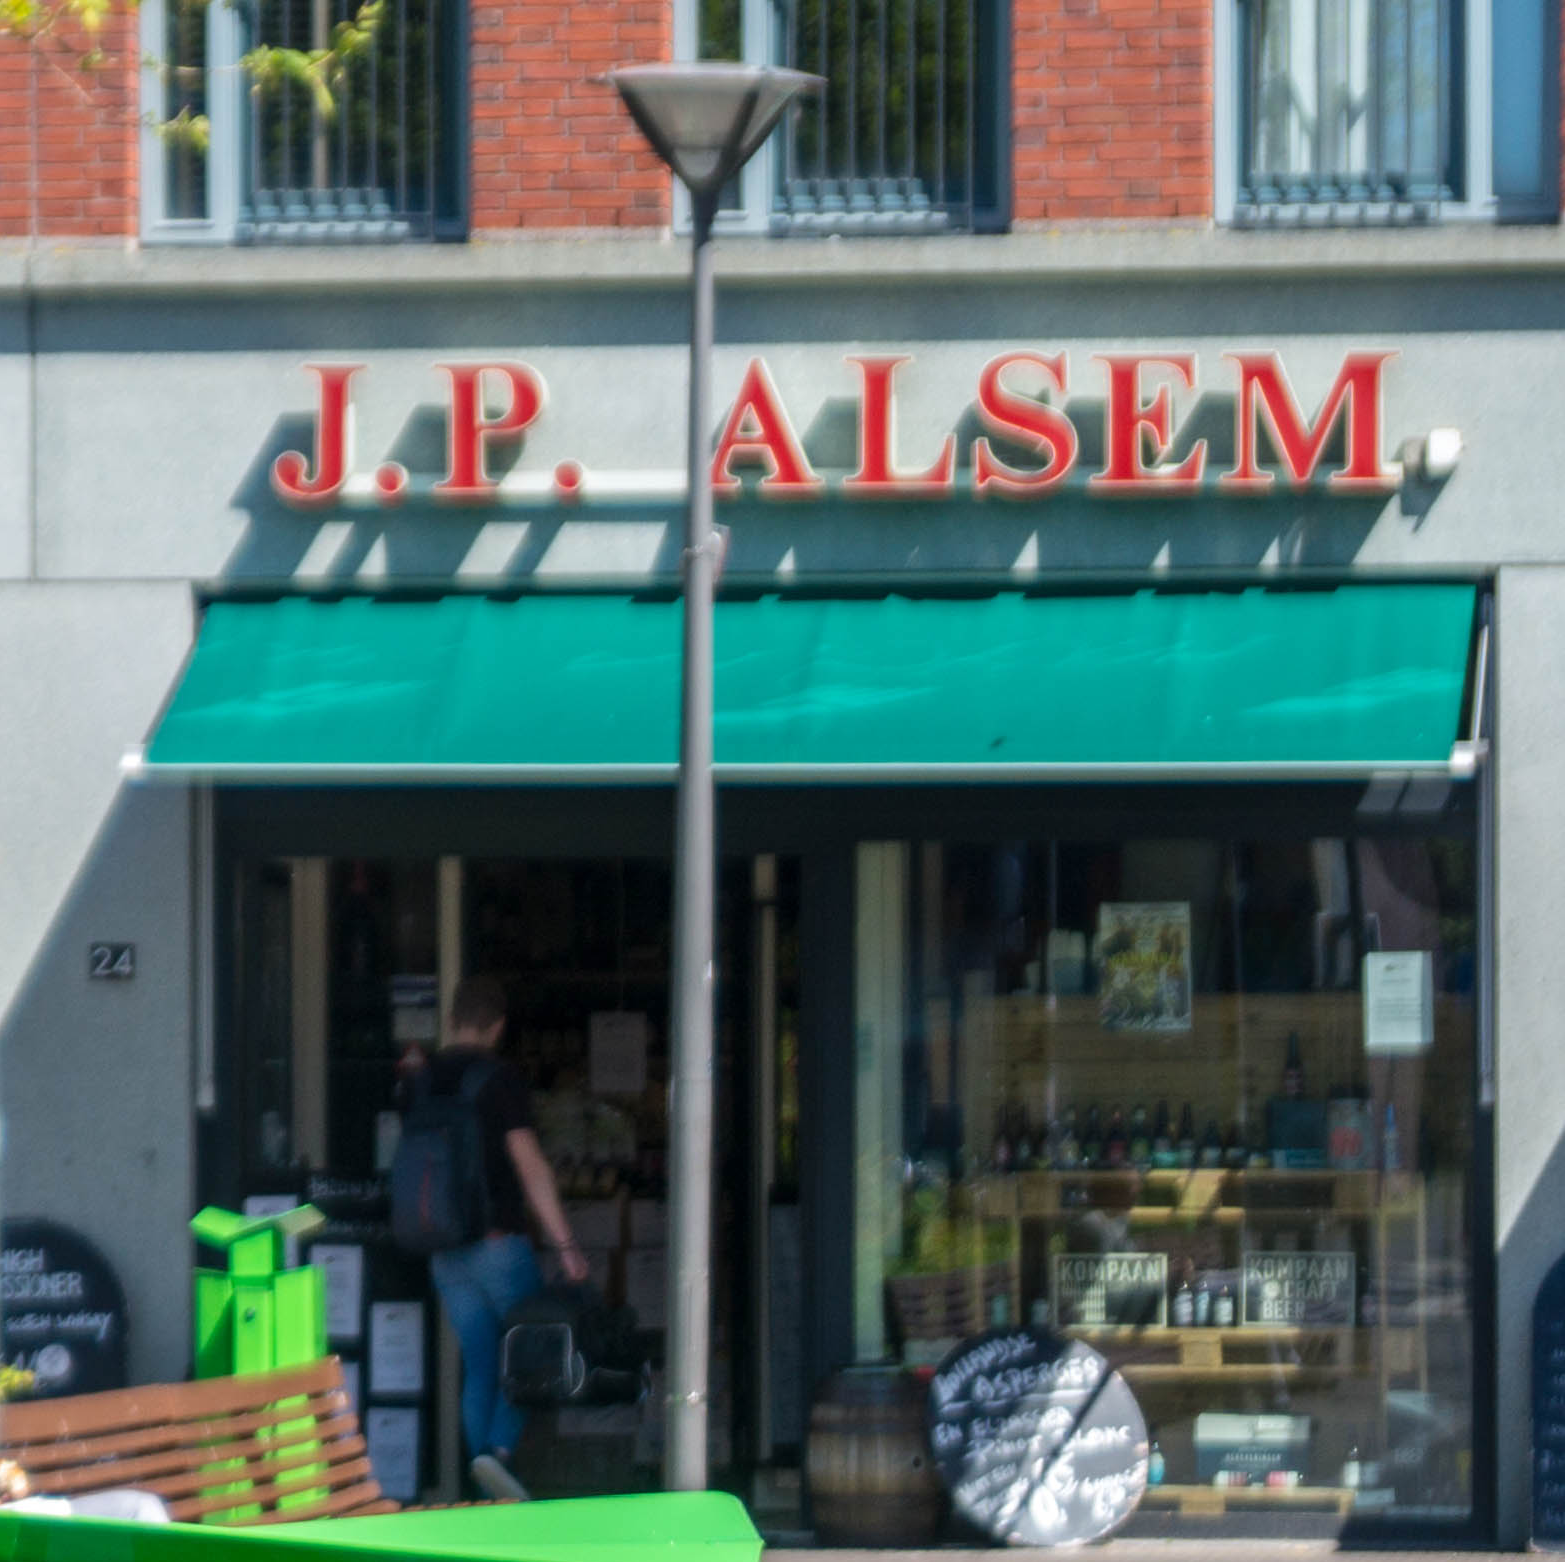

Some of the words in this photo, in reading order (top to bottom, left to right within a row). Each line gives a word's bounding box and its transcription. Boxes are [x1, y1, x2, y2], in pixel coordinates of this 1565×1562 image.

[271, 360, 587, 505] J.P.
[710, 348, 1403, 496] ALSEM
[93, 946, 133, 977] 24
[1061, 1260, 1160, 1281] KOMPAAN
[1249, 1258, 1348, 1280] KOMPAAN
[1285, 1280, 1338, 1299] CRAFT
[1262, 1301, 1305, 1320] BEER
